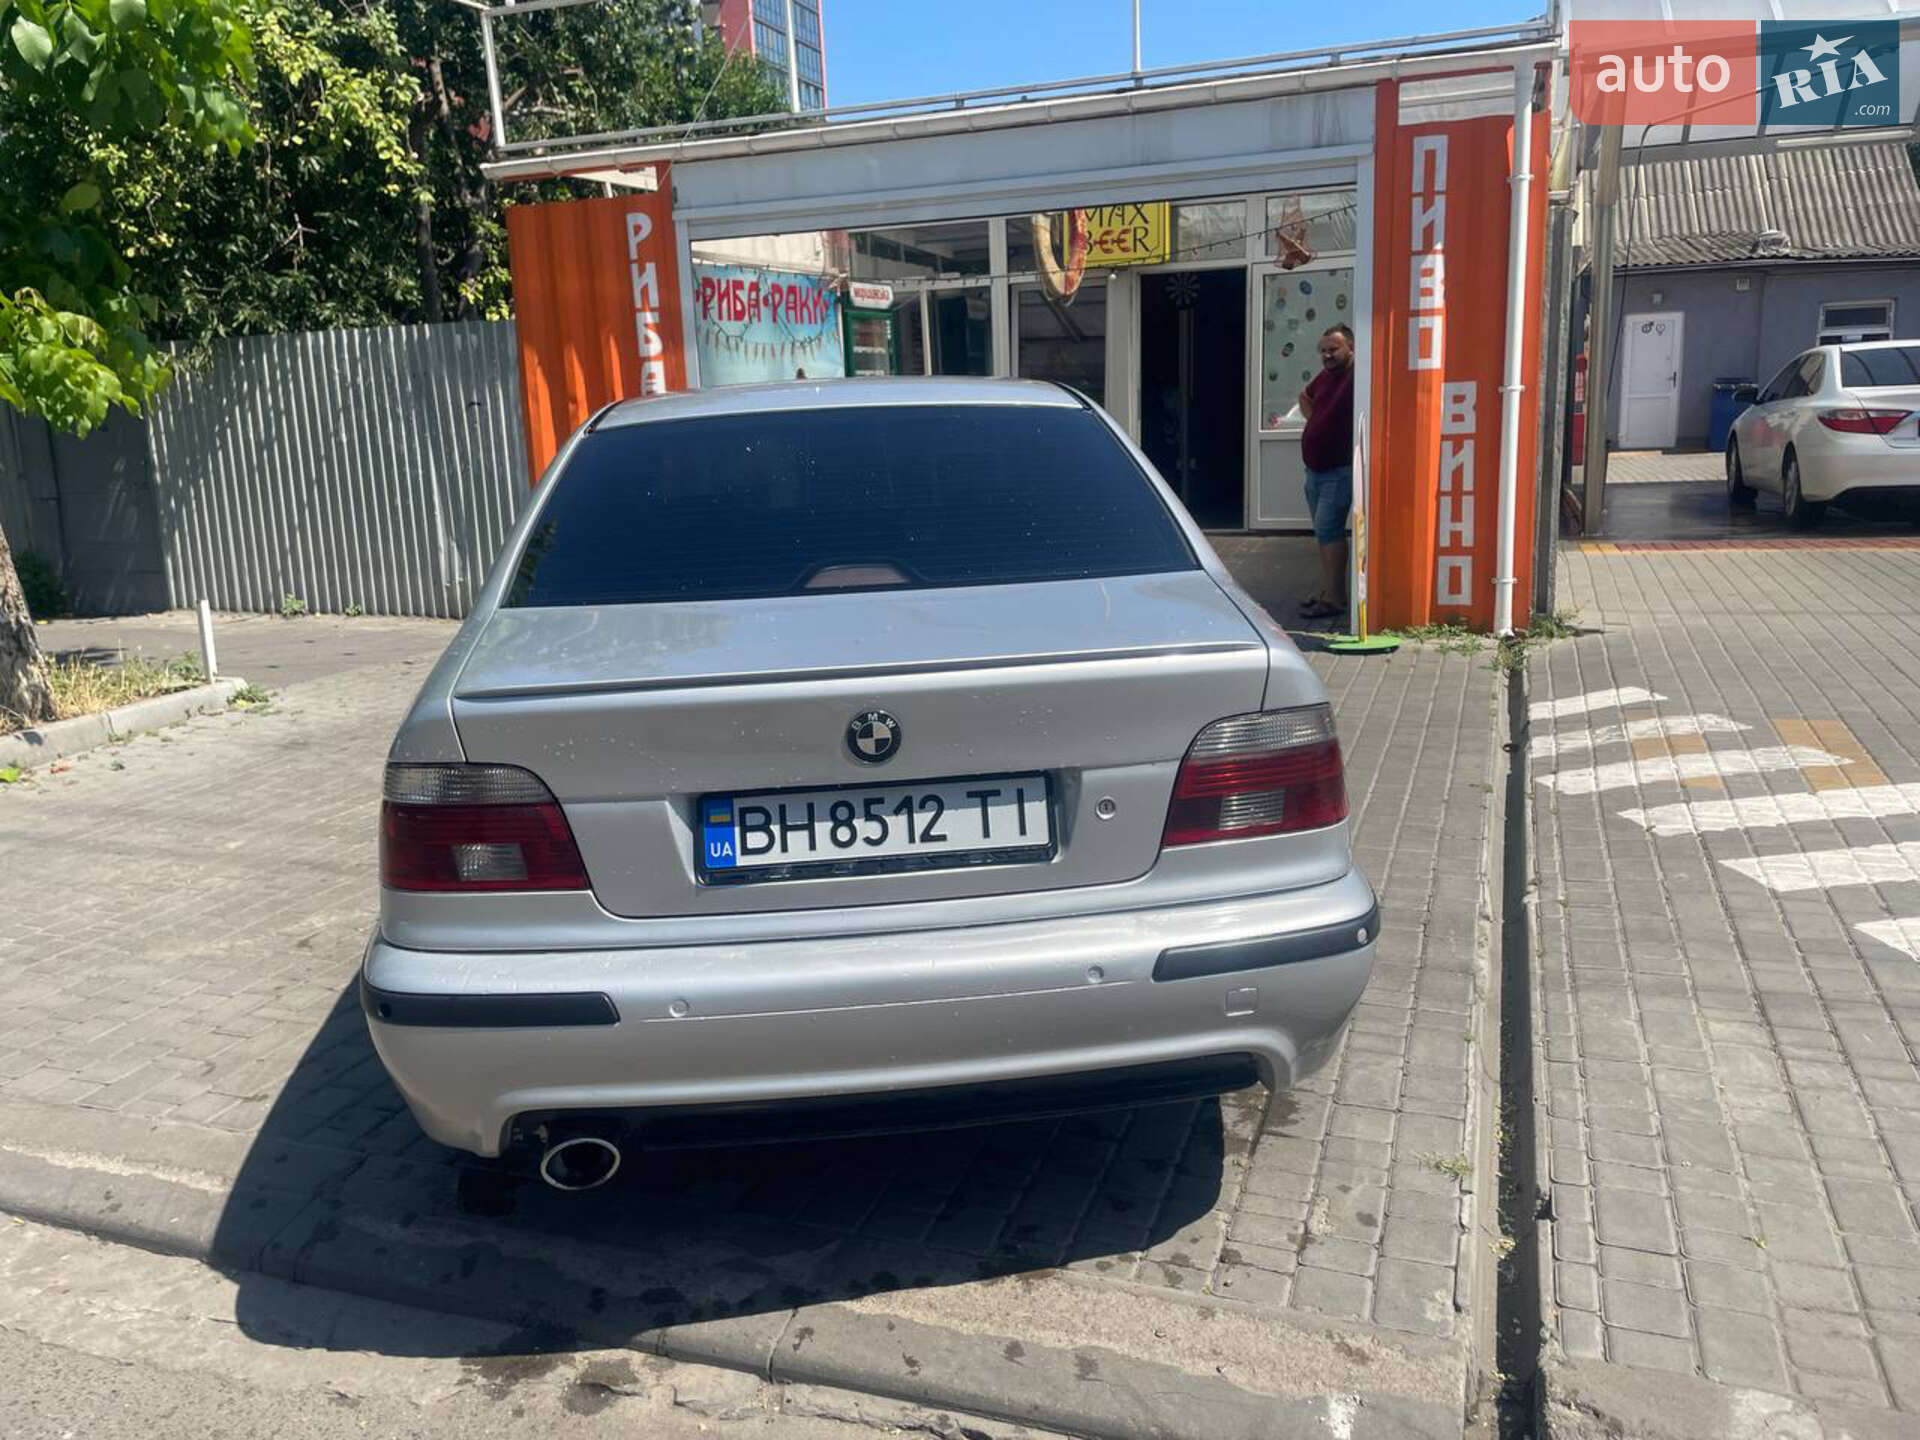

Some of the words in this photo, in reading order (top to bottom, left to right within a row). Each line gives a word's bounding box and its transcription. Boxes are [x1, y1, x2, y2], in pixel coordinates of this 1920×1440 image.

[1084, 203, 1149, 227] MAX
[1408, 135, 1449, 370] ПИВО
[626, 212, 667, 396] РИБА
[1437, 381, 1477, 606] ВИНО
[851, 713, 896, 730] BMW
[829, 793, 948, 848] 8512
[710, 842, 734, 859] UA
